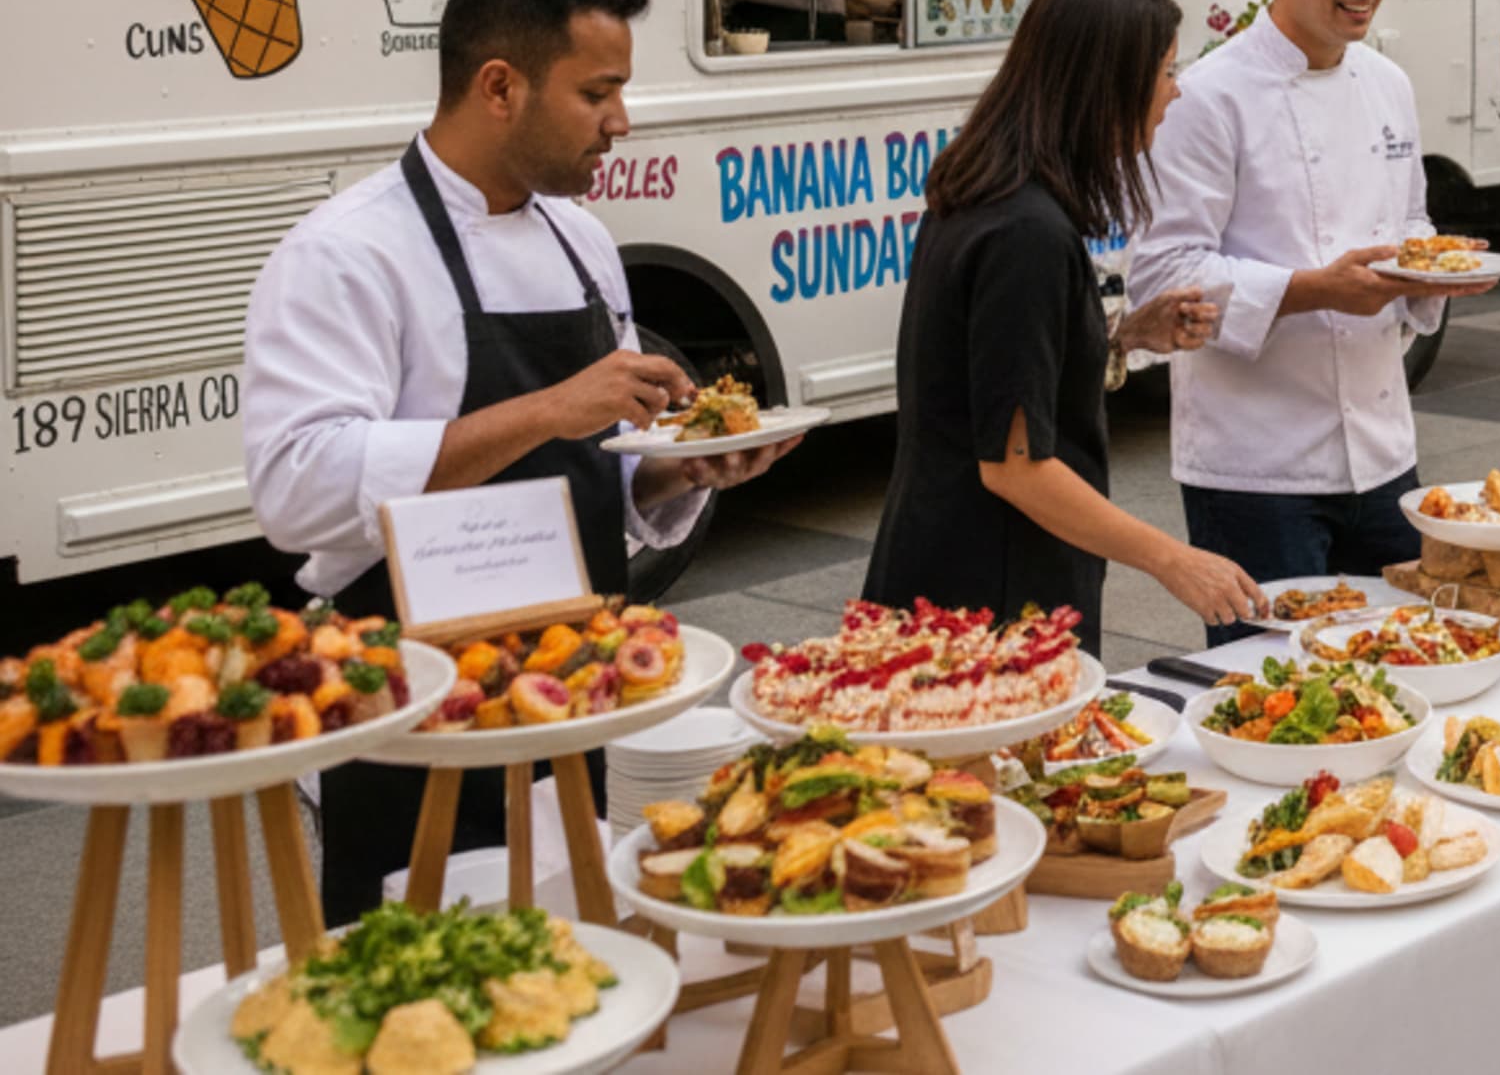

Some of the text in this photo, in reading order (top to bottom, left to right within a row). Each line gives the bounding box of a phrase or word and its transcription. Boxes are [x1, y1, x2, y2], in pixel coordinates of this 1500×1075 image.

[716, 136, 873, 223] BANANA
[13, 396, 86, 454] 189
[95, 381, 190, 440] SIERRA
